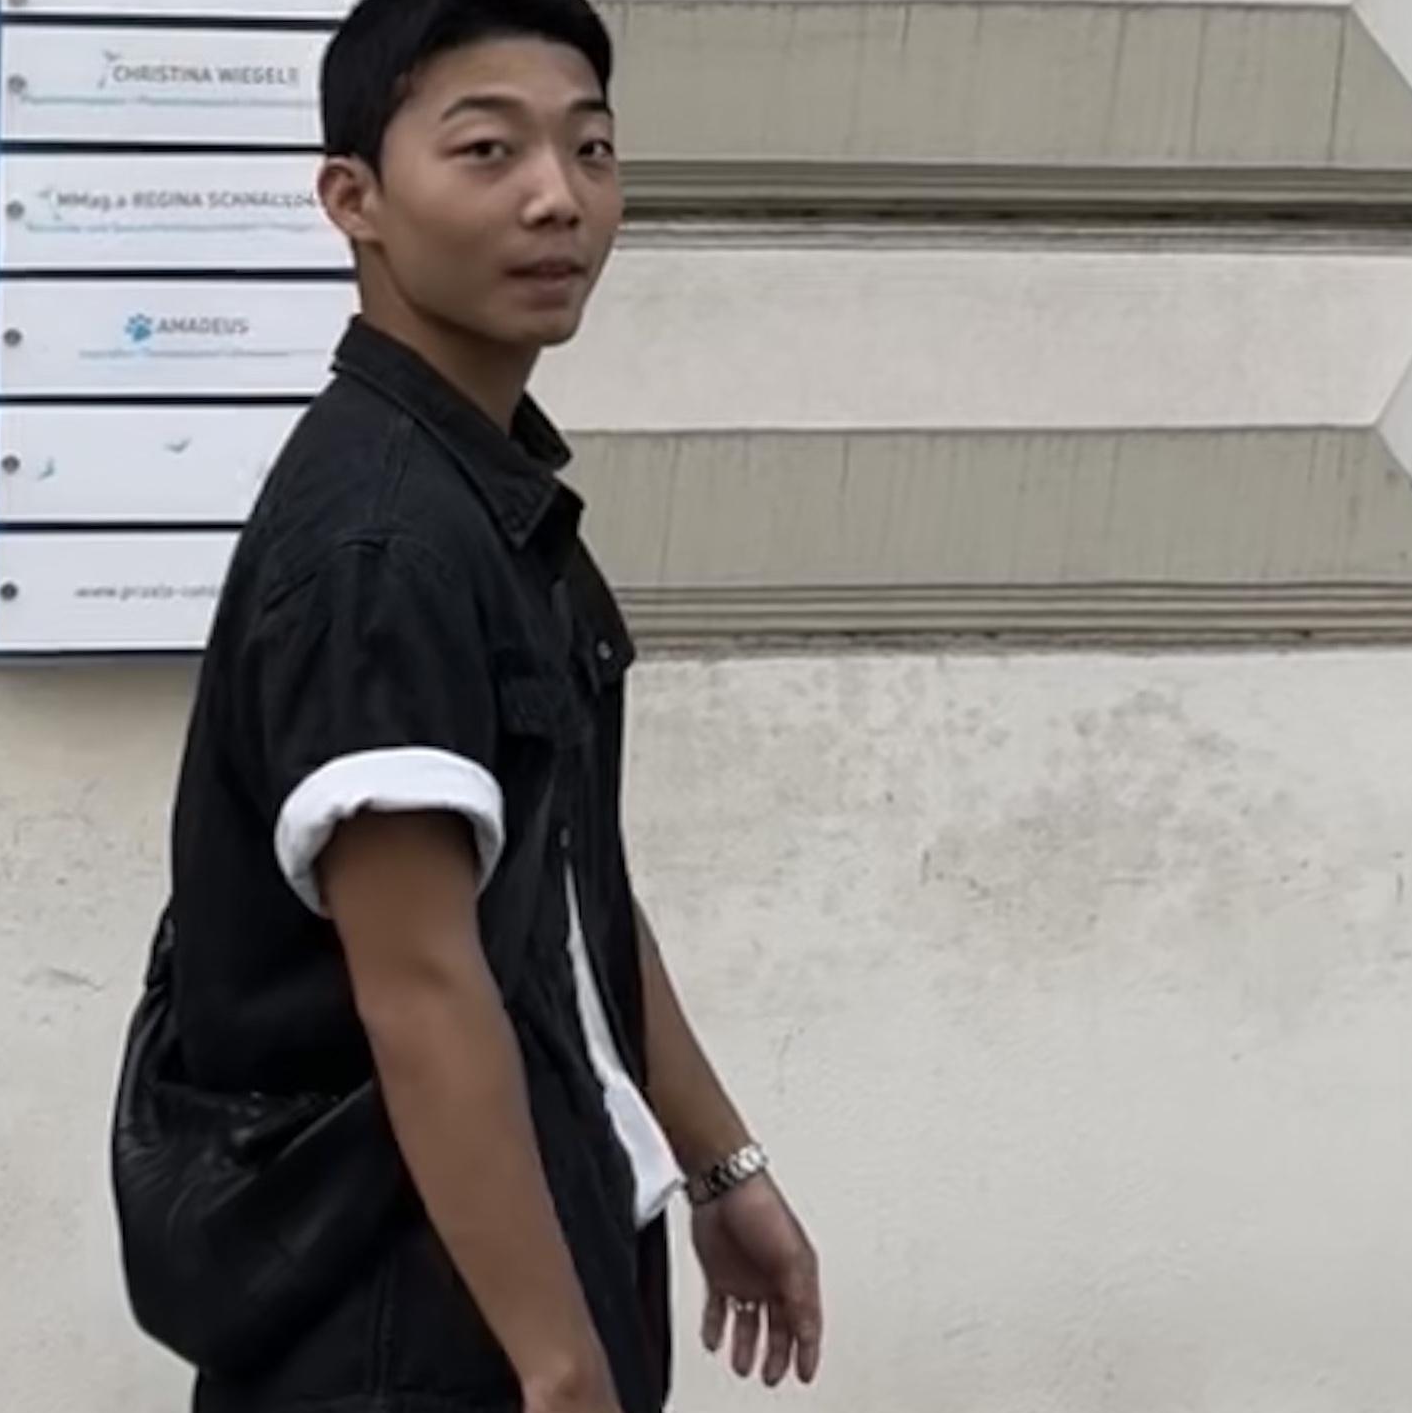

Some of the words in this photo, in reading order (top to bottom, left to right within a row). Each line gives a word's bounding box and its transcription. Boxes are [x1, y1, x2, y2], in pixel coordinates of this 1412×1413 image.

[112, 64, 214, 83] CHRISTINA
[132, 191, 203, 208] REGINA
[156, 317, 250, 335] AMADEUS
